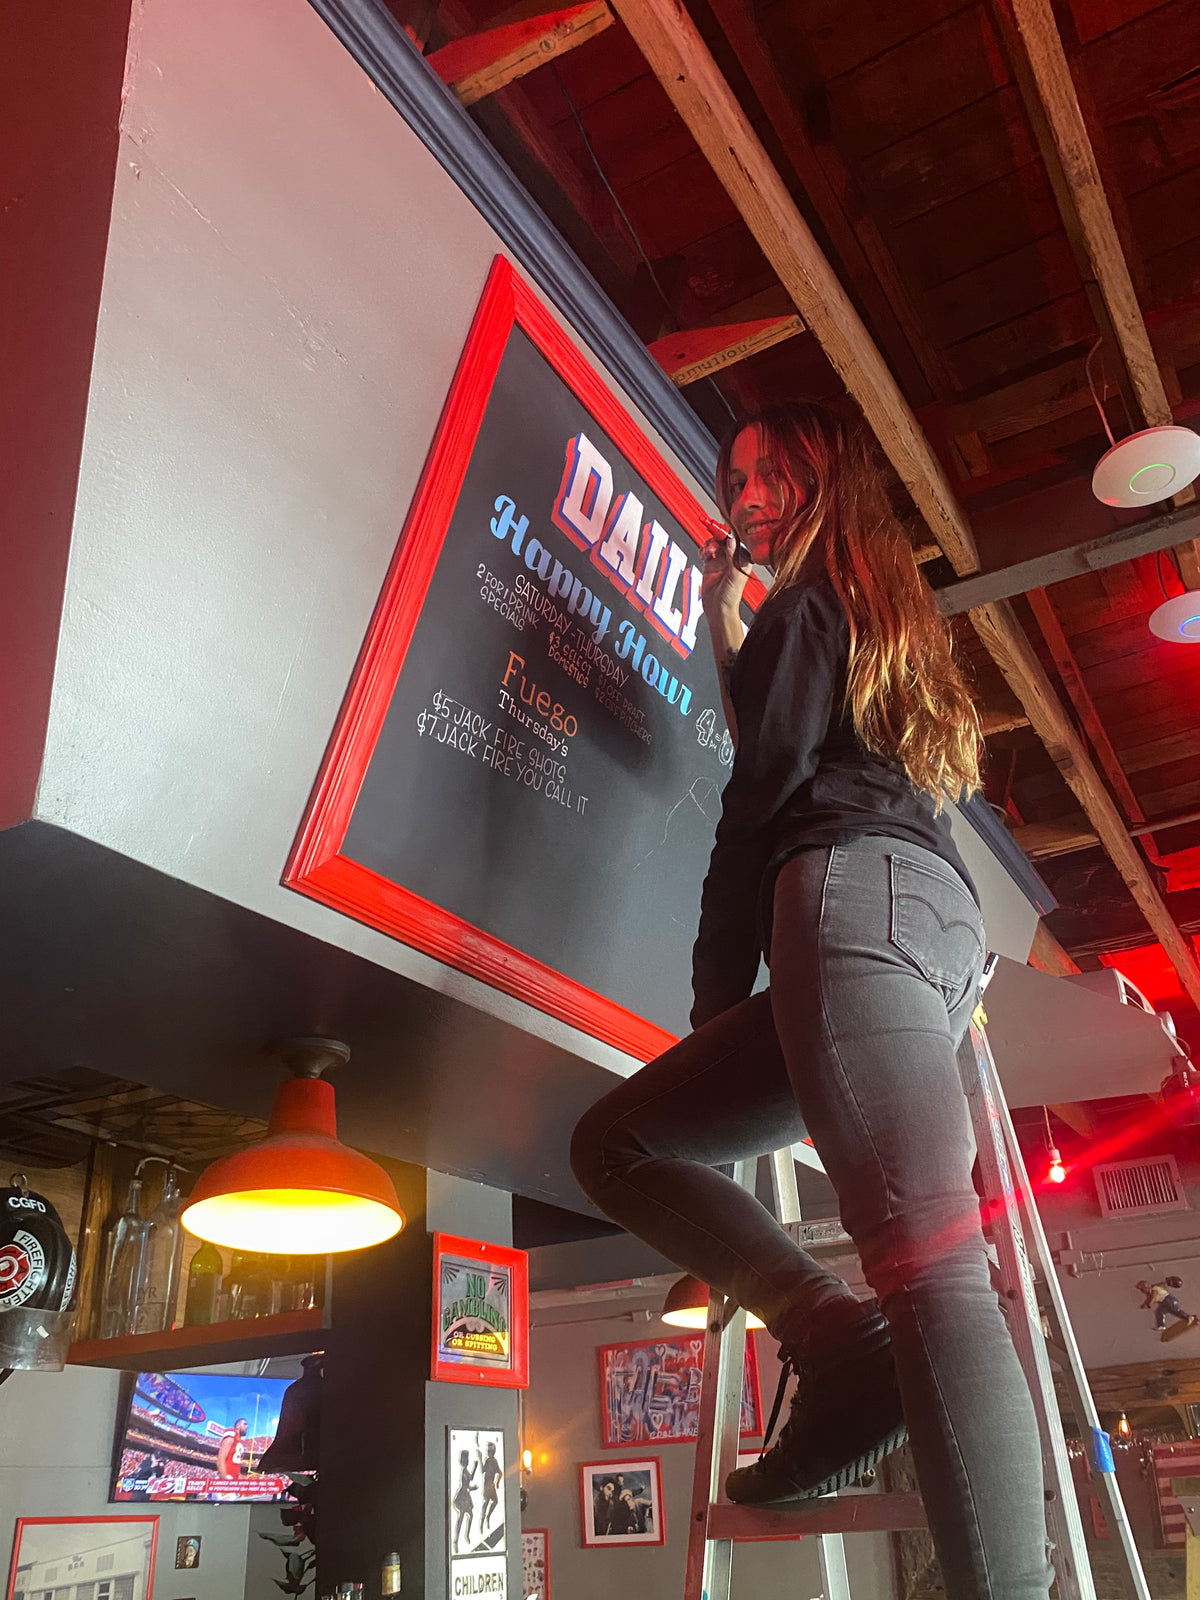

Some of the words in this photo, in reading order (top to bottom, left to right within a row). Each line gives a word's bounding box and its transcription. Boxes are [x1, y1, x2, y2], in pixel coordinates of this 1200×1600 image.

[551, 432, 704, 659] DAILY
[476, 562, 486, 579] 2
[484, 571, 505, 595] FOR
[509, 592, 540, 630] DRINK
[480, 585, 526, 632] SPECIALS
[490, 495, 611, 644] Happy
[615, 620, 693, 715] Hour
[514, 574, 572, 635] SATURDAY
[548, 646, 589, 688] DOMESTICS
[549, 631, 560, 649] $3
[563, 643, 592, 676] SELECT
[501, 650, 578, 737] Fuego
[623, 698, 646, 723] DRAFT
[432, 689, 453, 718] $5
[454, 706, 492, 740] JACK
[494, 728, 525, 760] FIRE
[528, 748, 566, 783] SHOTS
[498, 689, 569, 757] Thursday's
[620, 711, 653, 745] PITCHERS
[416, 708, 439, 736] $7
[438, 724, 479, 757] JACK
[482, 745, 513, 776] FIRE
[516, 762, 542, 791] YOU
[545, 780, 572, 808] CALL
[577, 795, 588, 815] IT
[8, 1196, 46, 1213] CGFD
[466, 1272, 486, 1299] NO
[443, 1299, 507, 1340] GAMBLING
[453, 1331, 464, 1339] OR
[452, 1338, 463, 1347] OR
[465, 1341, 498, 1351] SPITTING
[455, 1572, 504, 1596] CHILDREN
